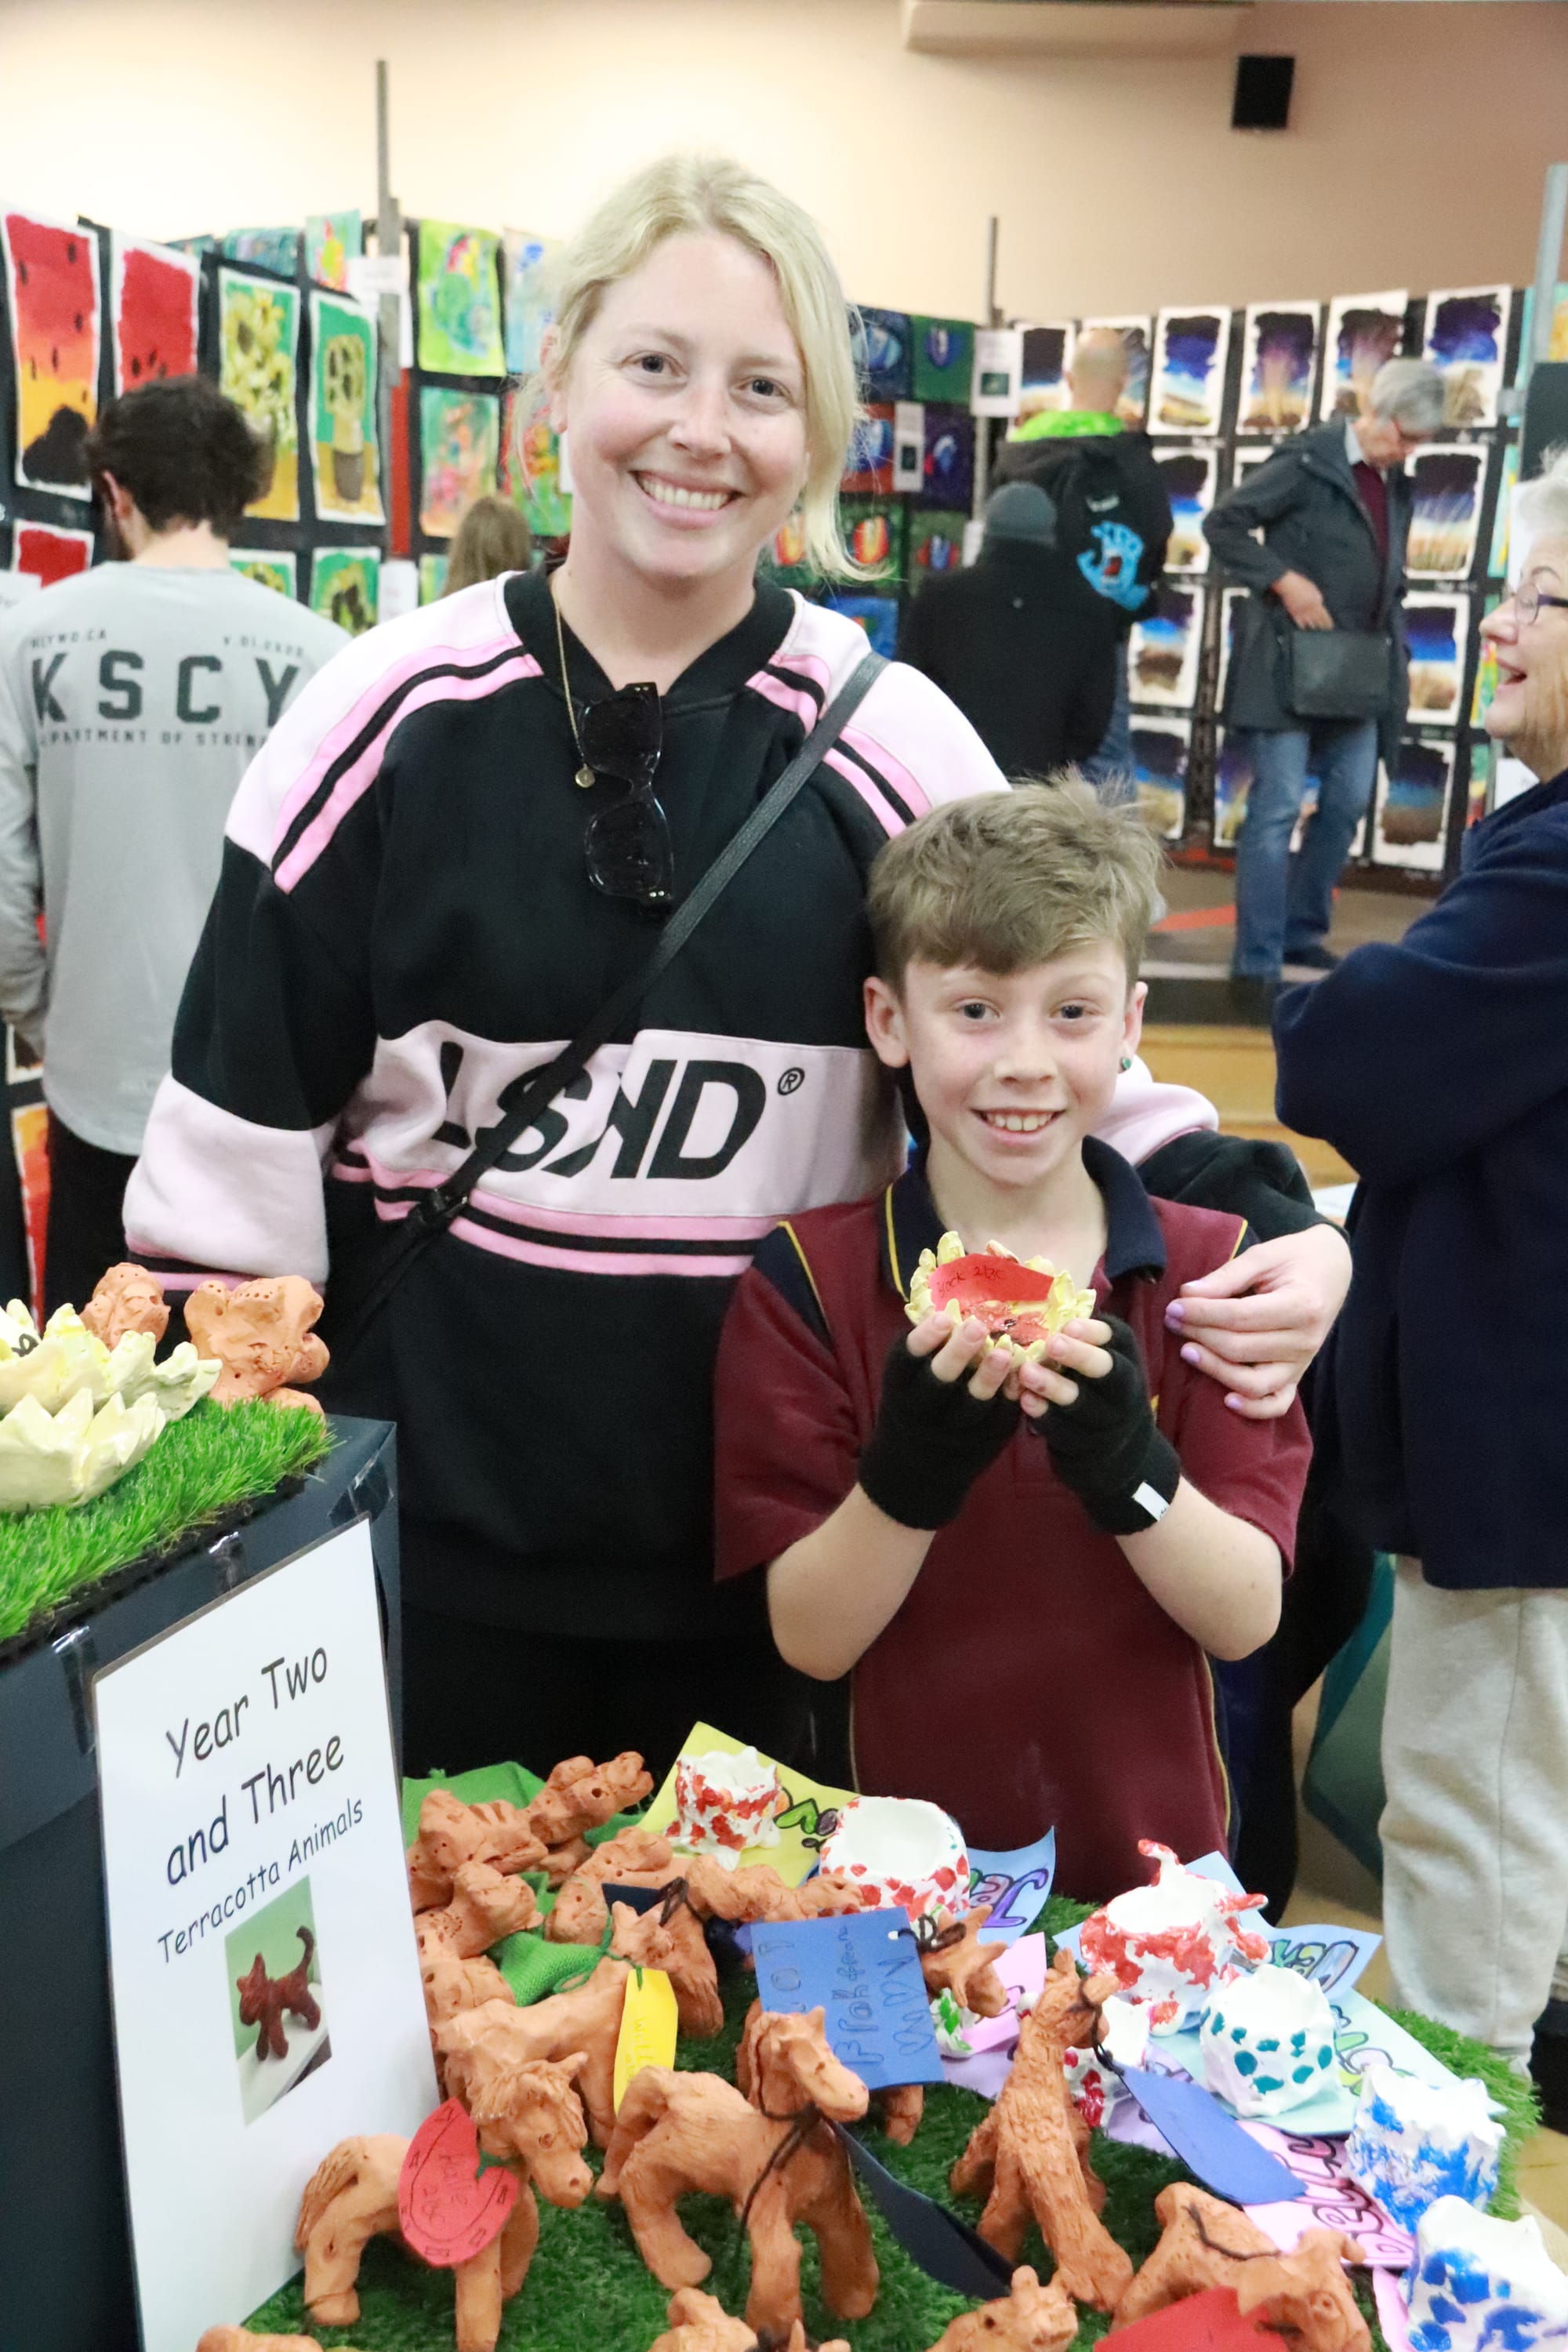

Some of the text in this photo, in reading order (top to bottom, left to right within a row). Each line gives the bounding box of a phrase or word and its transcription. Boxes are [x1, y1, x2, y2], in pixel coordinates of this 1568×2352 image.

[31, 649, 301, 728] KSCY
[162, 731, 183, 745] OF
[165, 1647, 328, 1779] Year Two
[165, 1734, 345, 1886] and Three
[157, 1798, 365, 1964] Terracotta Animals
